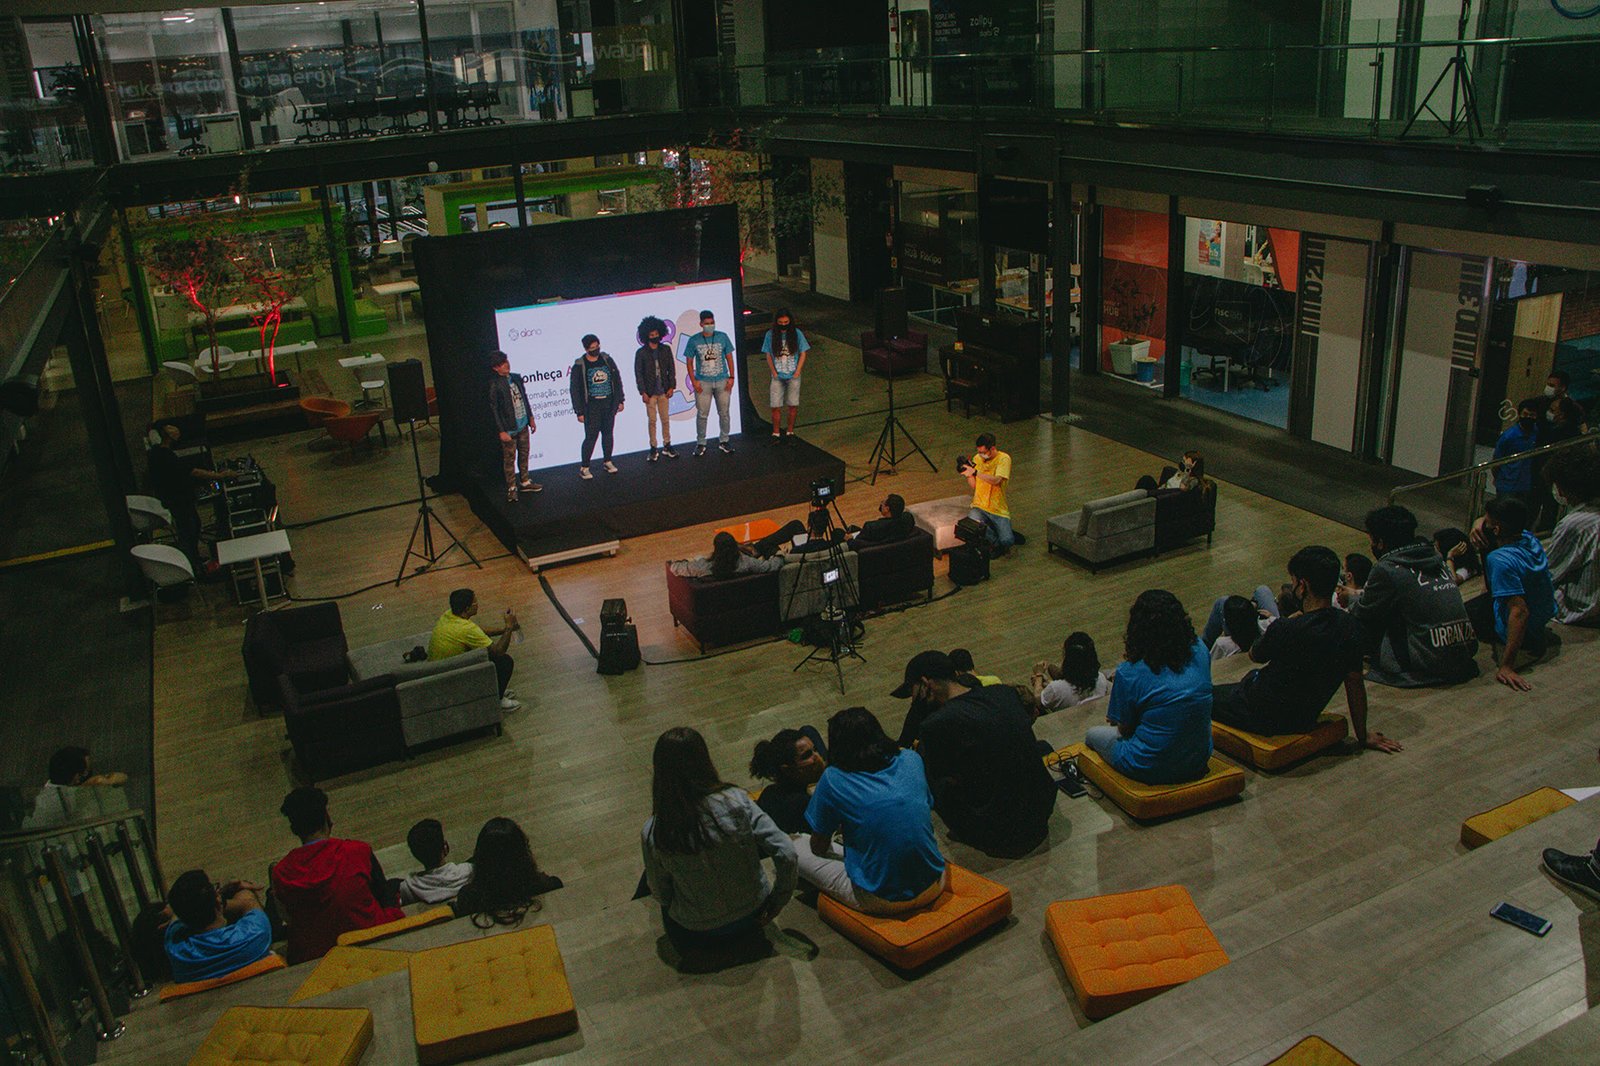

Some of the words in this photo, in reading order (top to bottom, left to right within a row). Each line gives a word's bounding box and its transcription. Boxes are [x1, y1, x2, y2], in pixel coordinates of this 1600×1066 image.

[522, 370, 562, 383] onheça
[528, 388, 558, 399] omação,
[531, 398, 570, 412] gajamento
[553, 407, 574, 418] atend
[1430, 623, 1465, 647] URBAN
